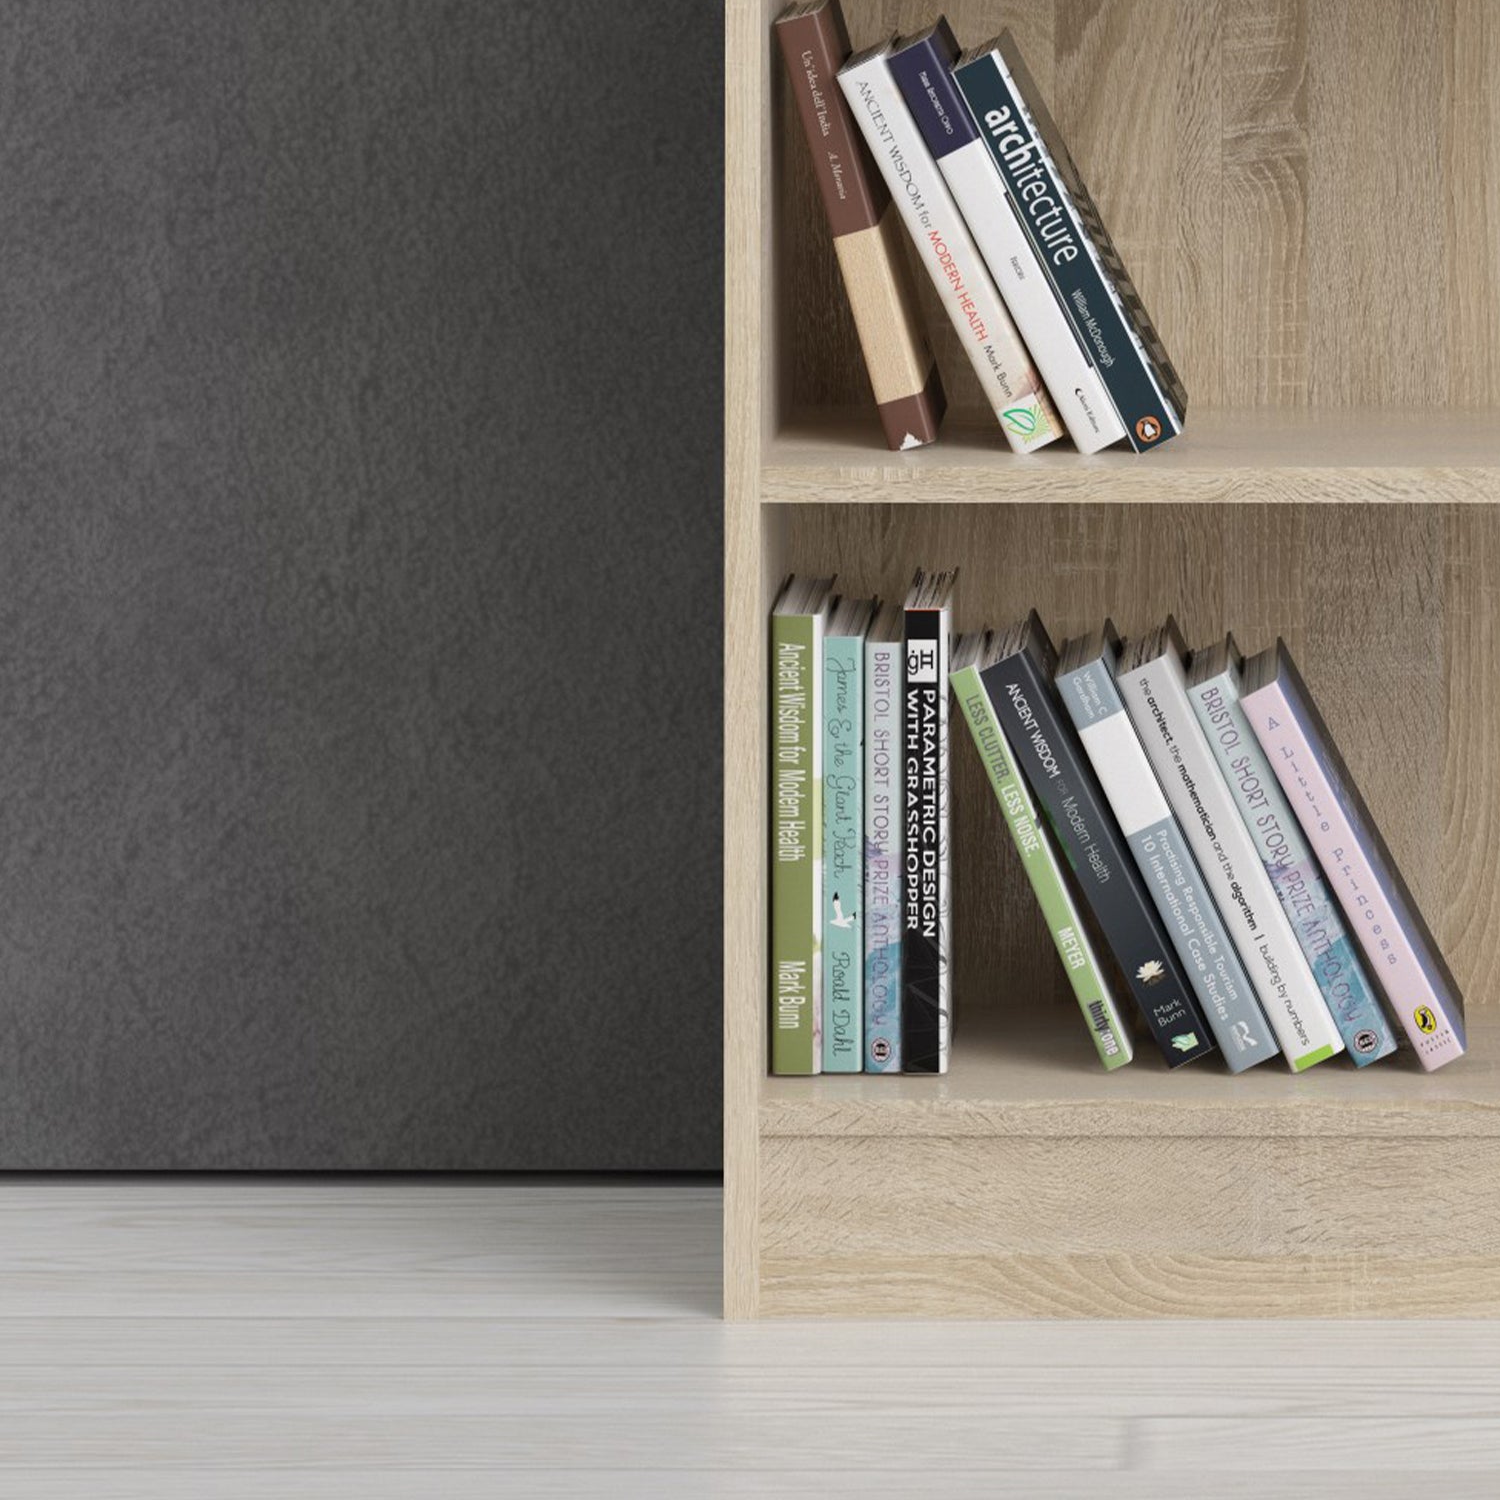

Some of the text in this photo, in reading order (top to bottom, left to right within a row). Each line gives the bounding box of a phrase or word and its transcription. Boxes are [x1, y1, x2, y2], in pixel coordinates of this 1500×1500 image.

[856, 77, 988, 342] ANCIENT WISDOM for MODERN HEALTH
[980, 98, 1089, 268] architecture
[1068, 287, 1095, 322] William
[981, 342, 1015, 399] Mark Bunn
[825, 656, 856, 713] James
[1080, 669, 1108, 716] William C
[1137, 676, 1154, 697] the
[777, 642, 806, 861] Ancient Wisdom for Modern Health
[1263, 714, 1281, 731] A
[833, 741, 852, 767] the
[964, 693, 1042, 859] LESS CLUTTER. LESS NOISE.
[1004, 679, 1113, 884] ANCIENT WISDOM FOR Modern Health
[1166, 743, 1184, 765] the
[826, 773, 856, 823] Giant
[906, 687, 919, 928] WITH GRASSHOPPER
[922, 688, 936, 937] PARAMETRIC DESIGN
[1175, 762, 1219, 842] mathematician
[871, 651, 890, 1025] BRISTOL SHORT STORY PRIZE ANTHOLOGY
[1199, 686, 1362, 1024] BRISTOL SHORT STORY PRIZE ANTHOLOGY
[1209, 839, 1228, 864] and
[1220, 861, 1237, 882] the
[1139, 834, 1232, 1022] 10 International Case Studies
[1153, 828, 1187, 886] Practising
[1179, 885, 1219, 956] Responsible
[1212, 954, 1241, 1000] Tourism
[1227, 880, 1260, 933] algorithm
[1056, 925, 1086, 970] MEYER
[777, 960, 806, 1028] Mark Bunn
[831, 951, 854, 1056] Roald Dahl
[1151, 996, 1183, 1018] Mark
[1155, 1005, 1186, 1027] Bunn
[1255, 942, 1312, 1047] building by numbers
